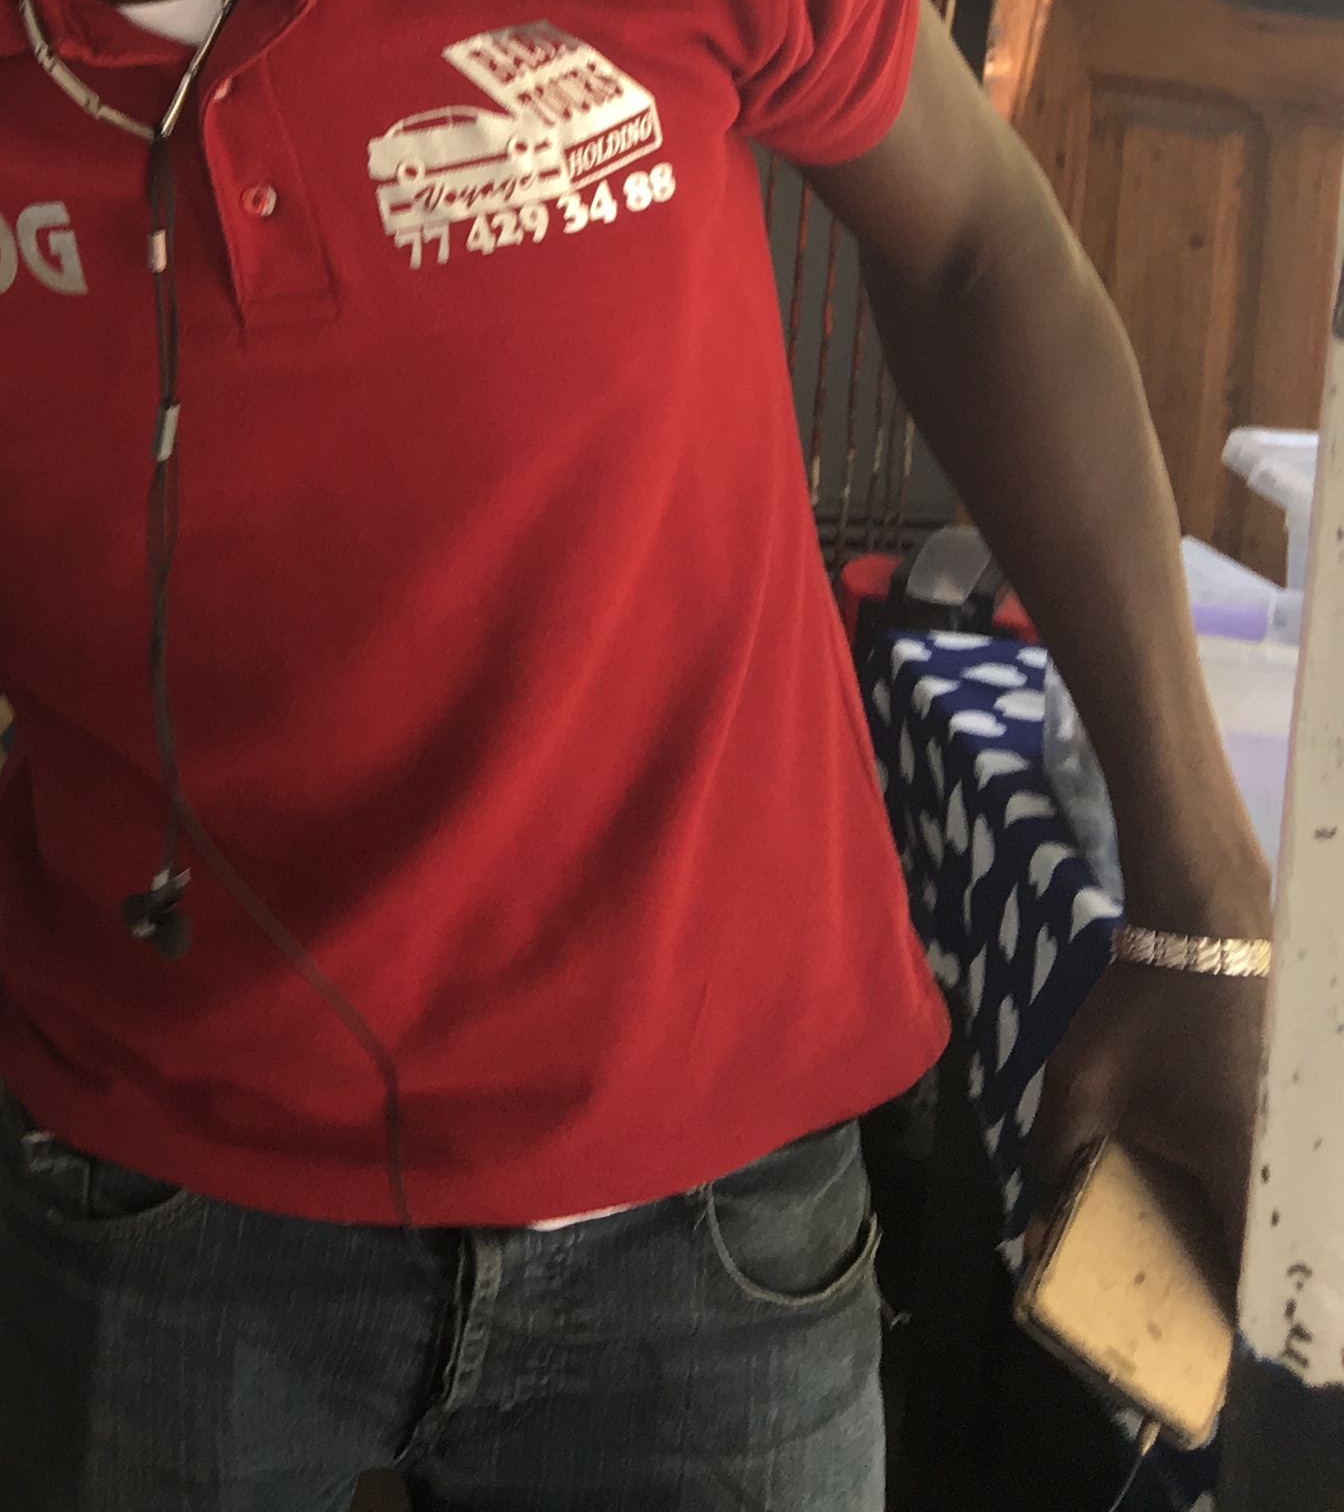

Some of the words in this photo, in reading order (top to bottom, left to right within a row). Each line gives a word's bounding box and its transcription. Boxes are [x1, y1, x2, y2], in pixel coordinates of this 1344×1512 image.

[567, 112, 653, 178] HOLDING
[394, 219, 450, 271] 77
[466, 201, 549, 256] 429
[557, 179, 618, 235] 34
[623, 161, 677, 212] 88
